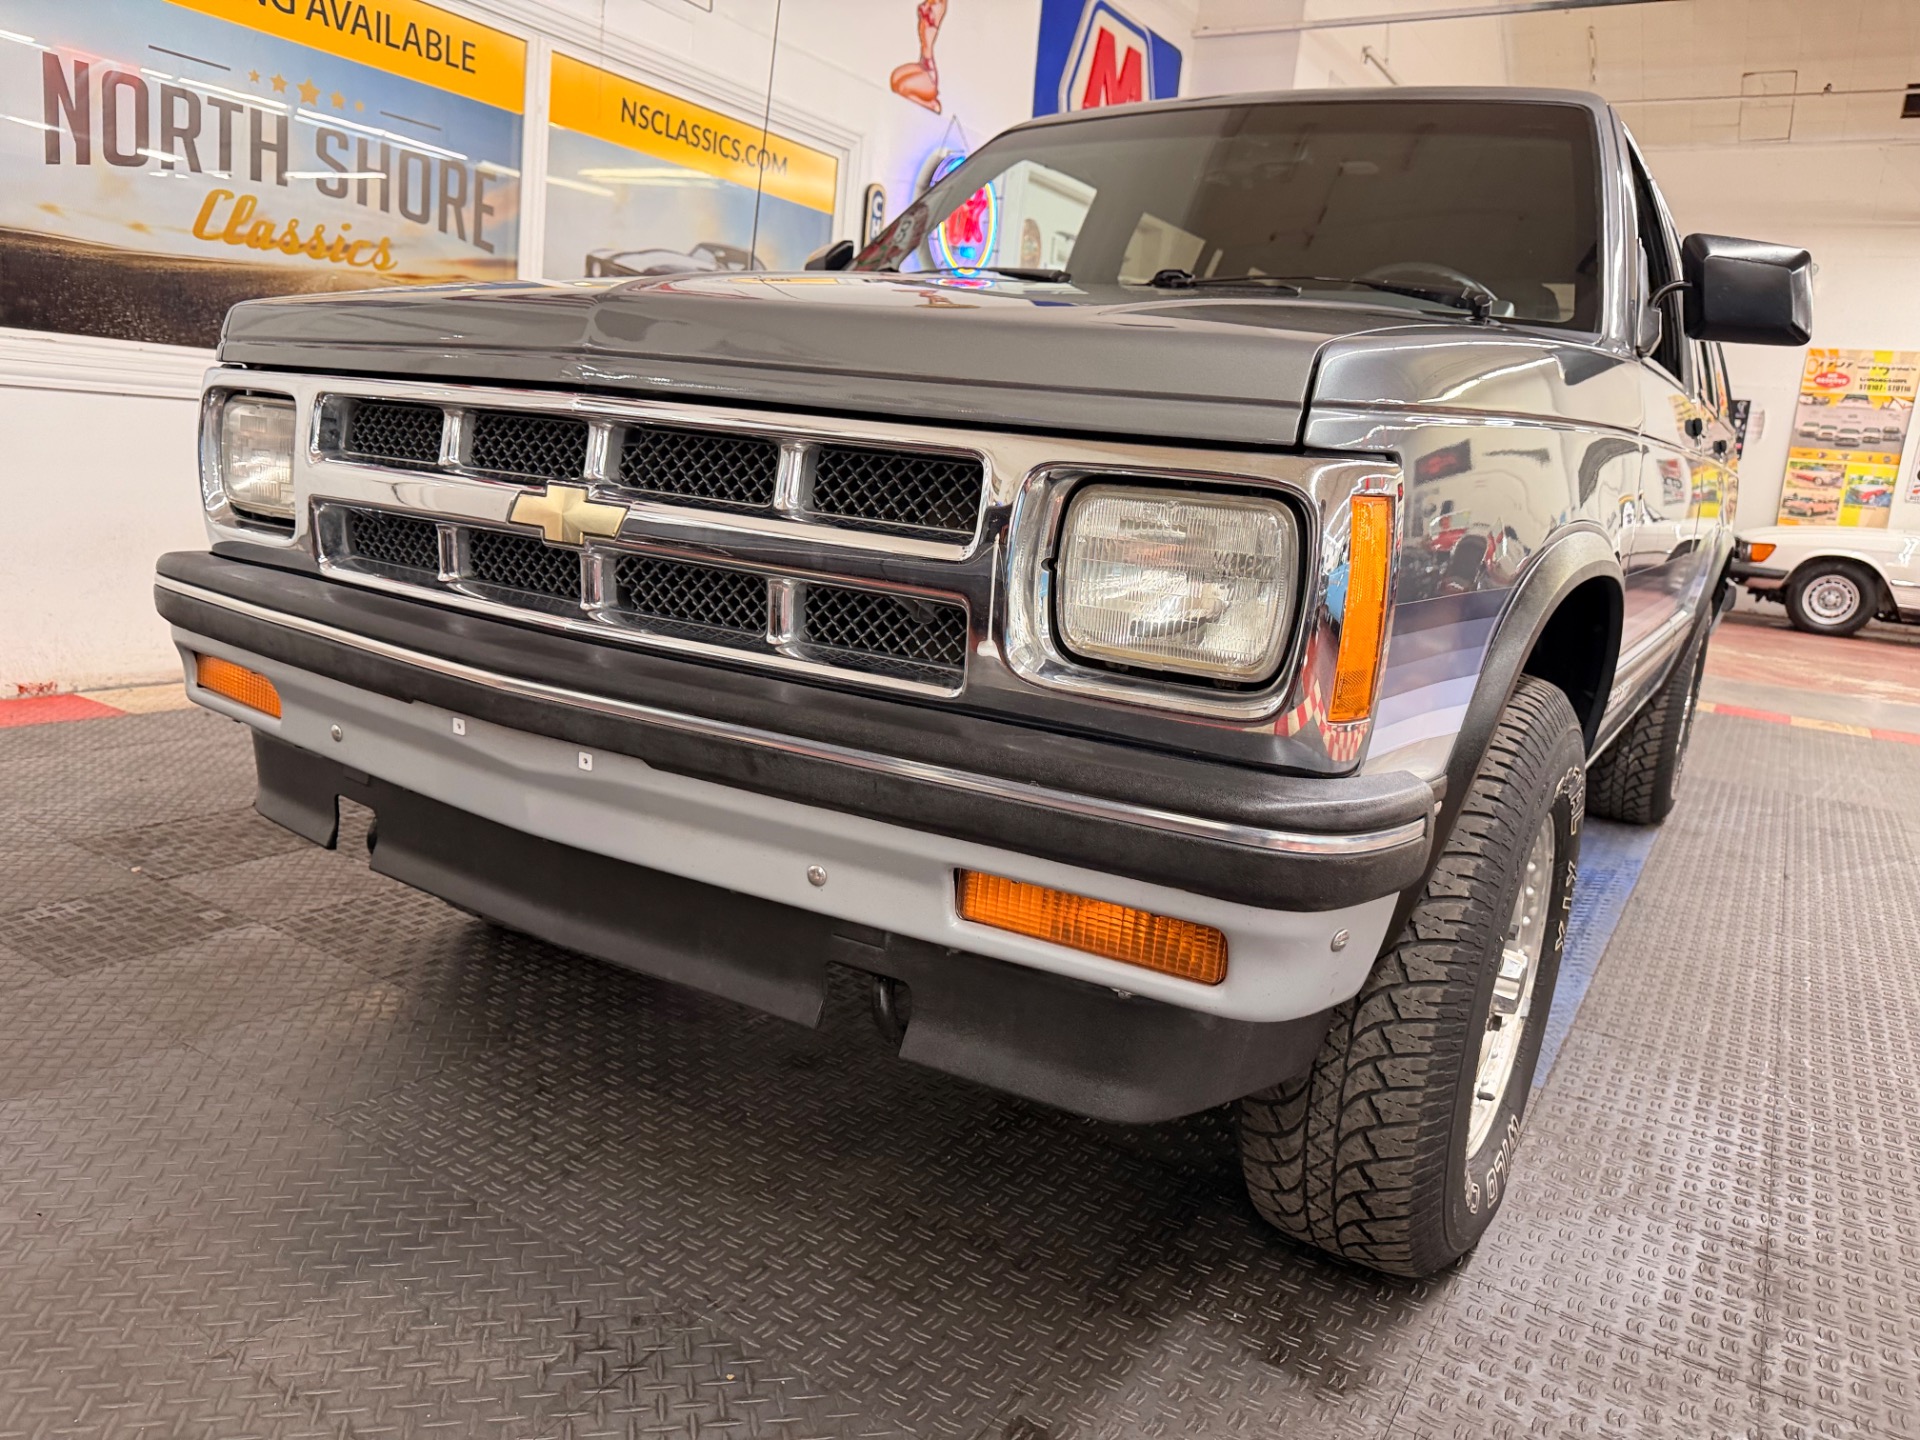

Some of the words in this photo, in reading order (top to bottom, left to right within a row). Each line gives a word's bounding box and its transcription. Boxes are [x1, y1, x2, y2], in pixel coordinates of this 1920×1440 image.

[305, 0, 476, 74] AVAILABLE
[41, 51, 290, 187] NORTH
[315, 127, 497, 254] SHORE
[621, 97, 788, 176] NSCLASSICS.COM
[193, 189, 398, 271] Classics
